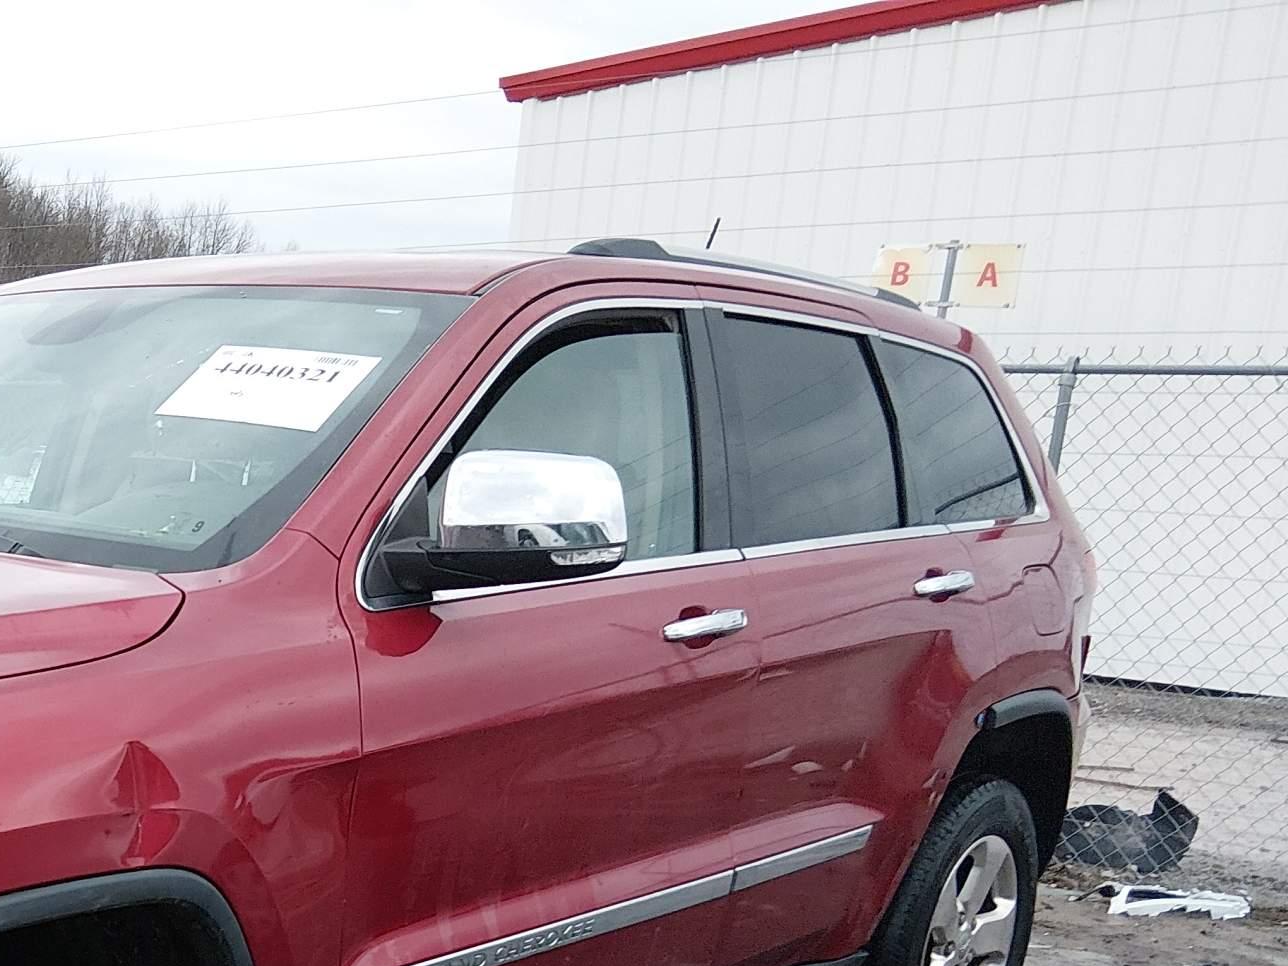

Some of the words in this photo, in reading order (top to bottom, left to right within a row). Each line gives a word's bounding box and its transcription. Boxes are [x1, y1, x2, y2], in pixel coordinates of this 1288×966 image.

[890, 261, 911, 286] B
[976, 261, 998, 288] A
[214, 361, 341, 383] 44040321
[191, 520, 205, 533] 9
[493, 918, 596, 962] CHEROKEE
